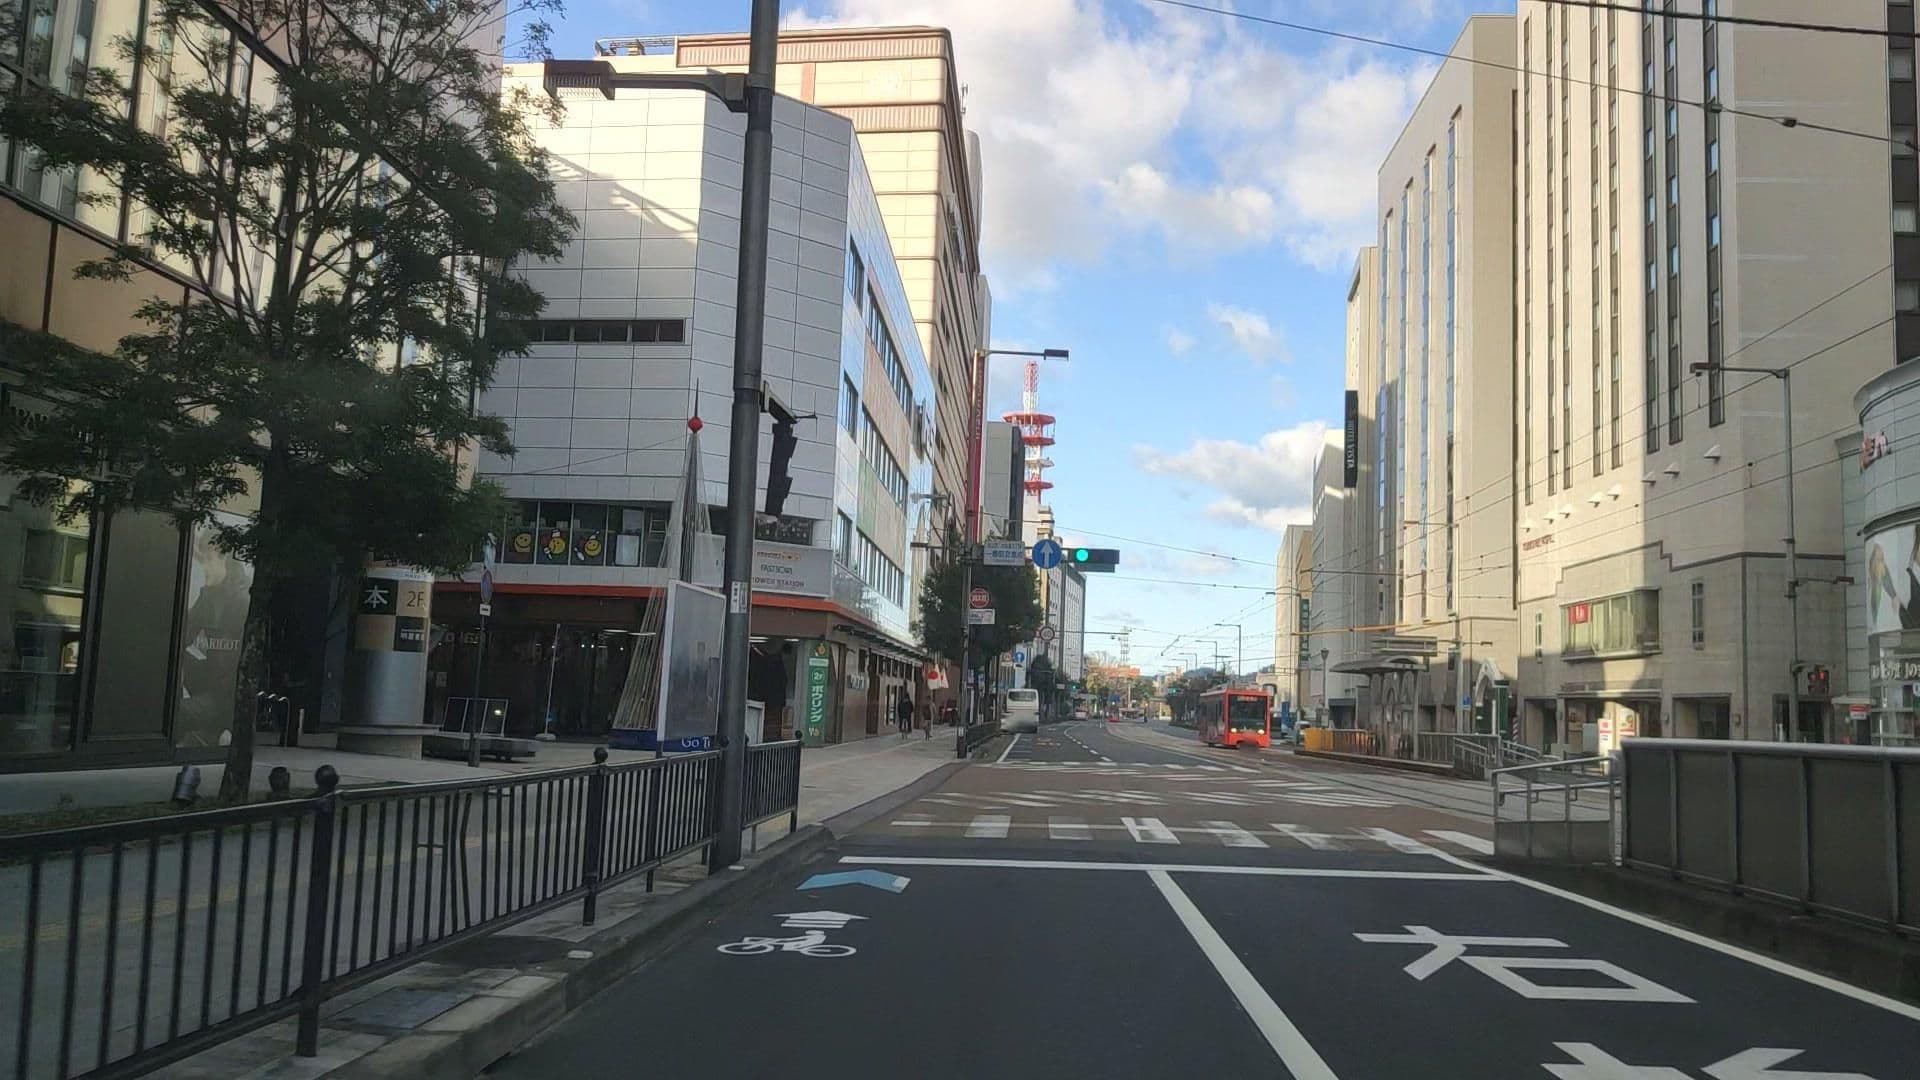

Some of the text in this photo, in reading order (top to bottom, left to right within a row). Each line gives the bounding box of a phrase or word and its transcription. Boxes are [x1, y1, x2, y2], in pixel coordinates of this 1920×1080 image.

[363, 584, 389, 609] 本
[407, 590, 425, 608] 2F
[681, 737, 700, 748] Go
[1352, 925, 1698, 1003] 右
